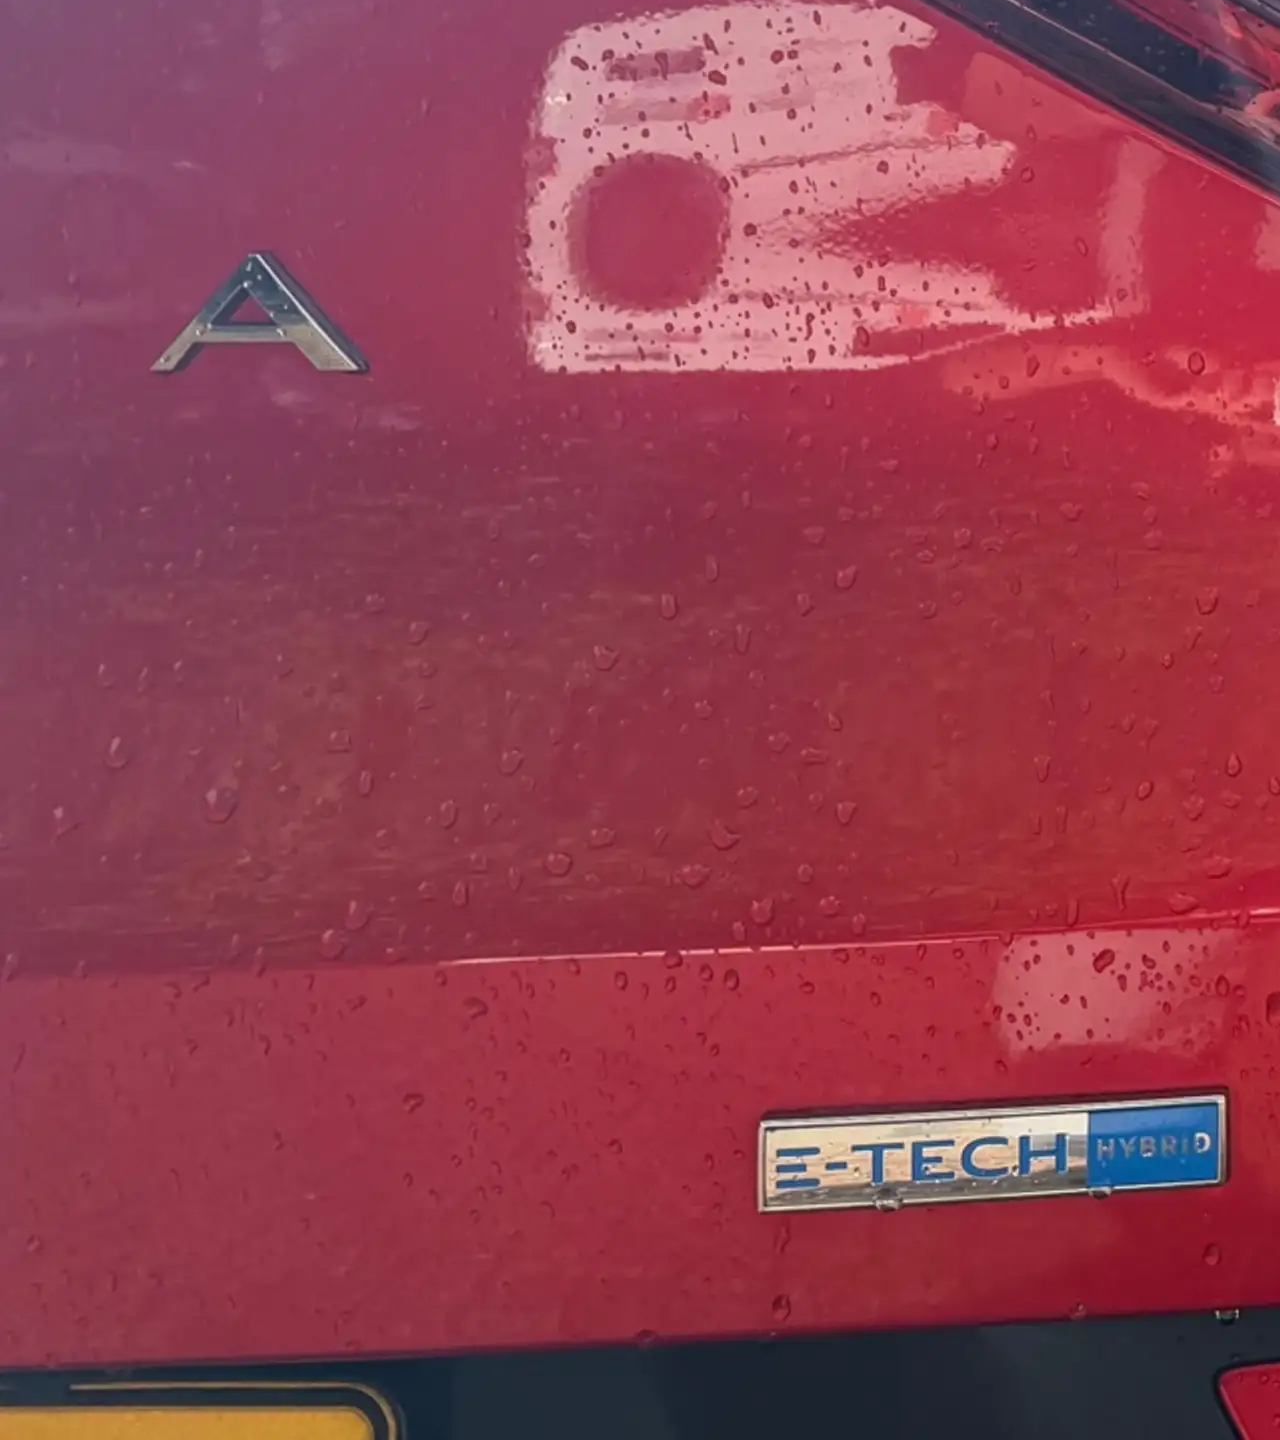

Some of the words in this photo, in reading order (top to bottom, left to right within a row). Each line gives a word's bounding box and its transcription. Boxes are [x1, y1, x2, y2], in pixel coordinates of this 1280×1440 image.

[150, 250, 369, 373] A
[775, 1132, 1069, 1190] E-TECH
[1096, 1131, 1212, 1161] HYBRID
